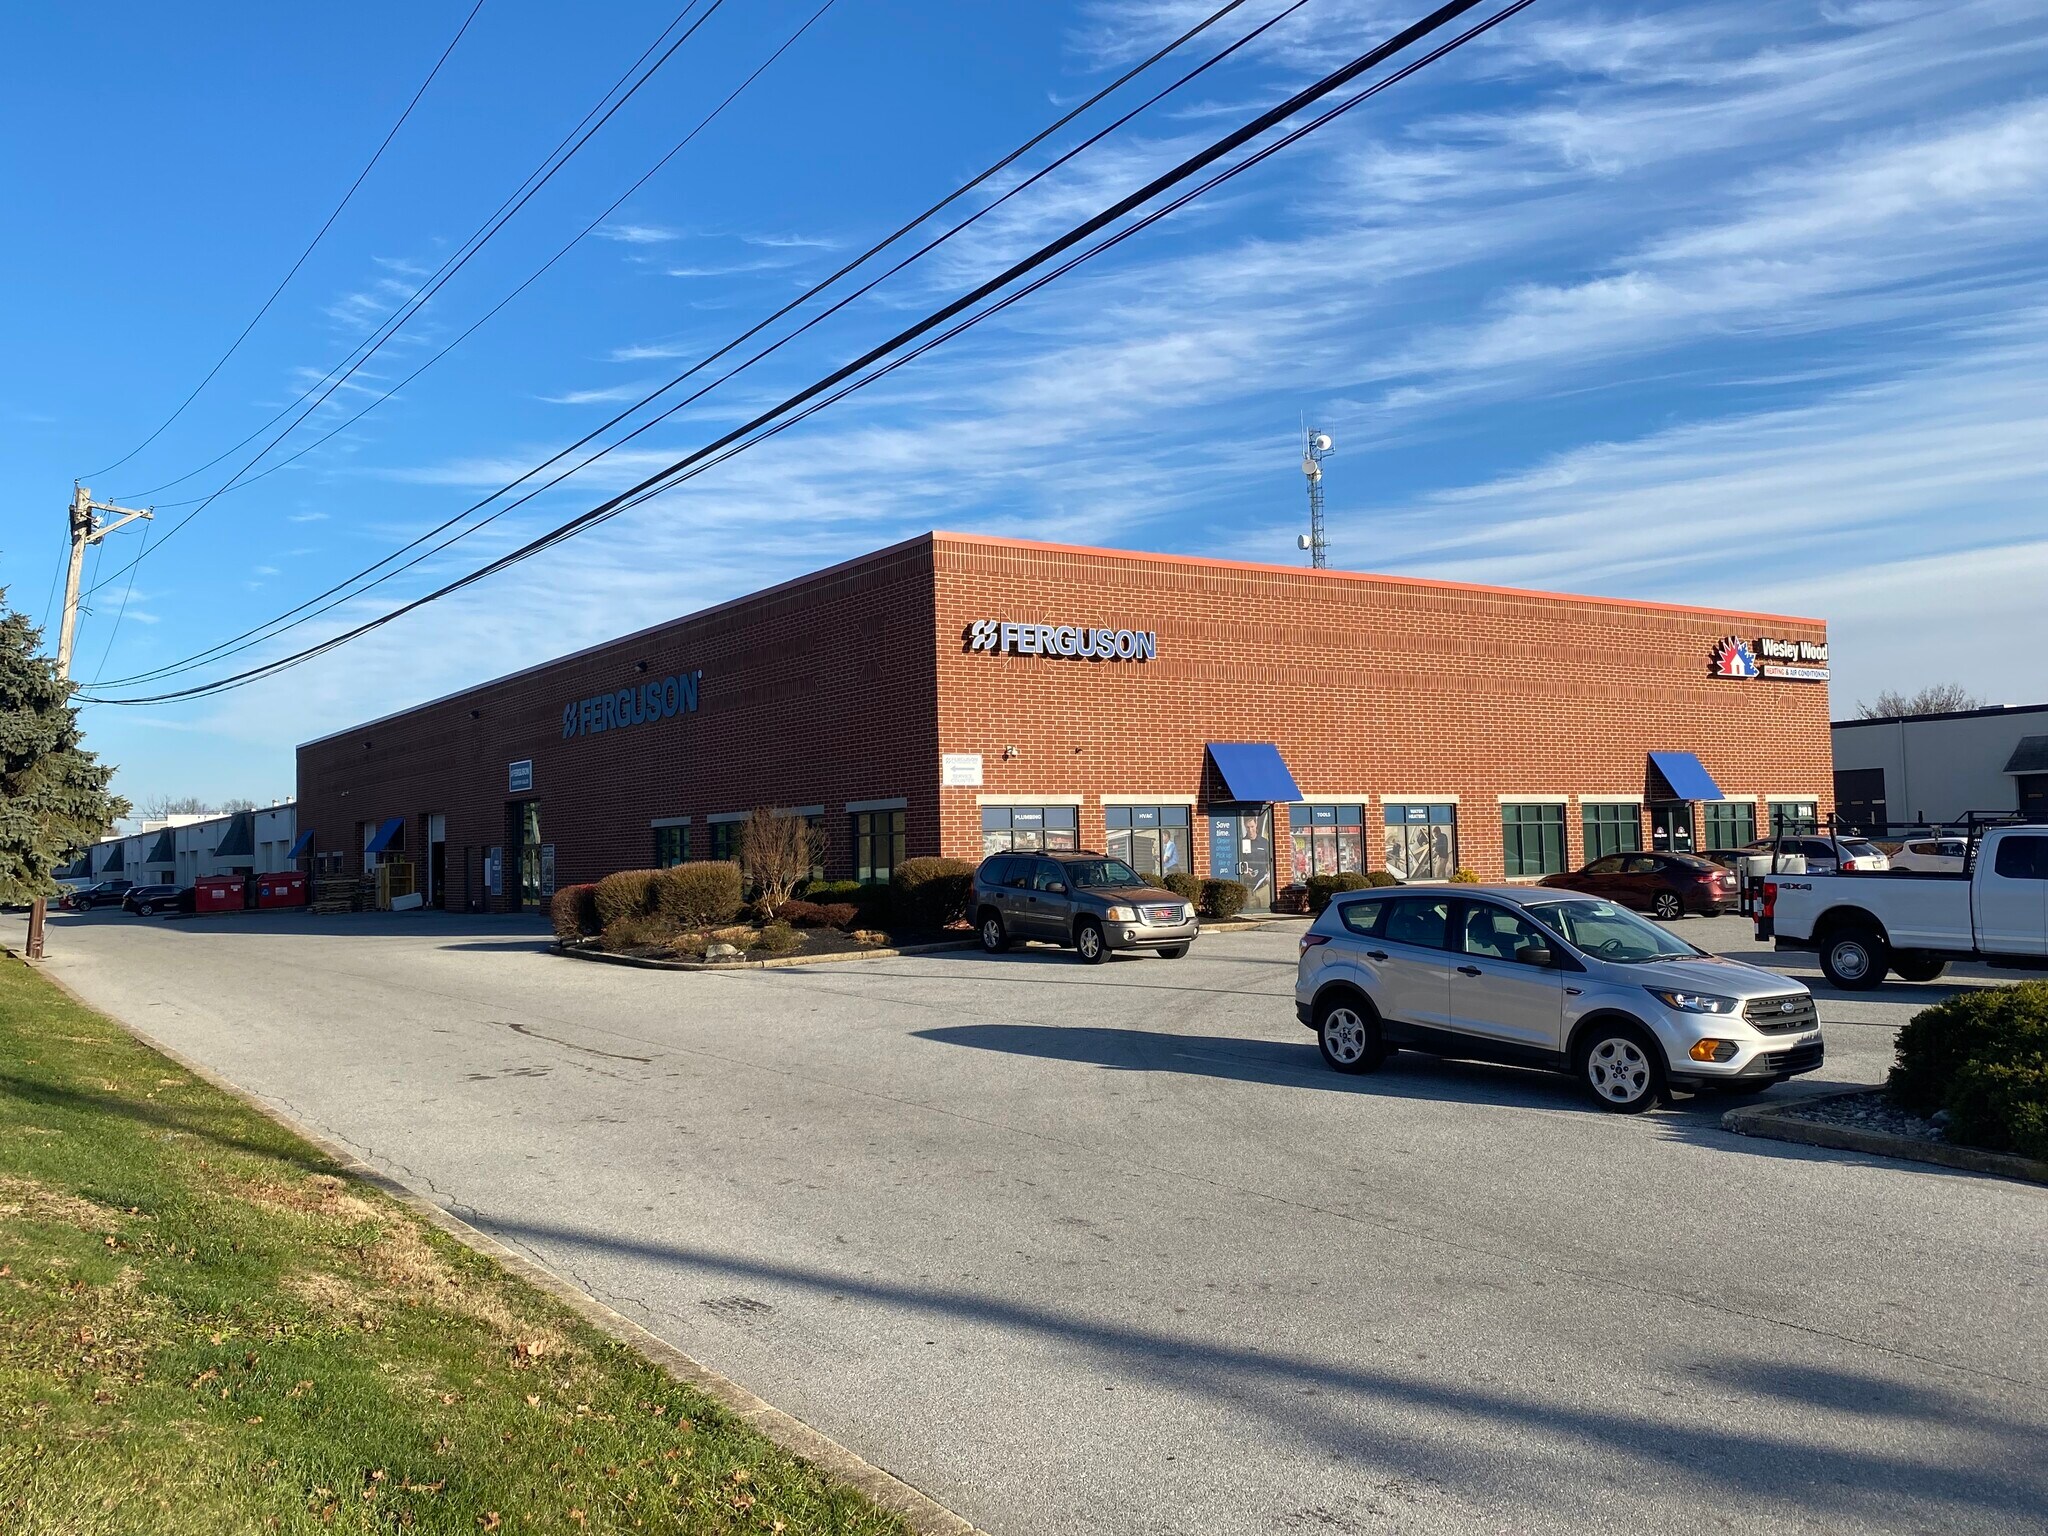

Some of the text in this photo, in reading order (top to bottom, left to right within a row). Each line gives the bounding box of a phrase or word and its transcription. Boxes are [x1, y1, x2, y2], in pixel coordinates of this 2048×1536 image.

[1000, 622, 1156, 659] FERGUSON
[1762, 638, 1828, 662] Wesley Wood
[579, 670, 698, 737] FERGUSON
